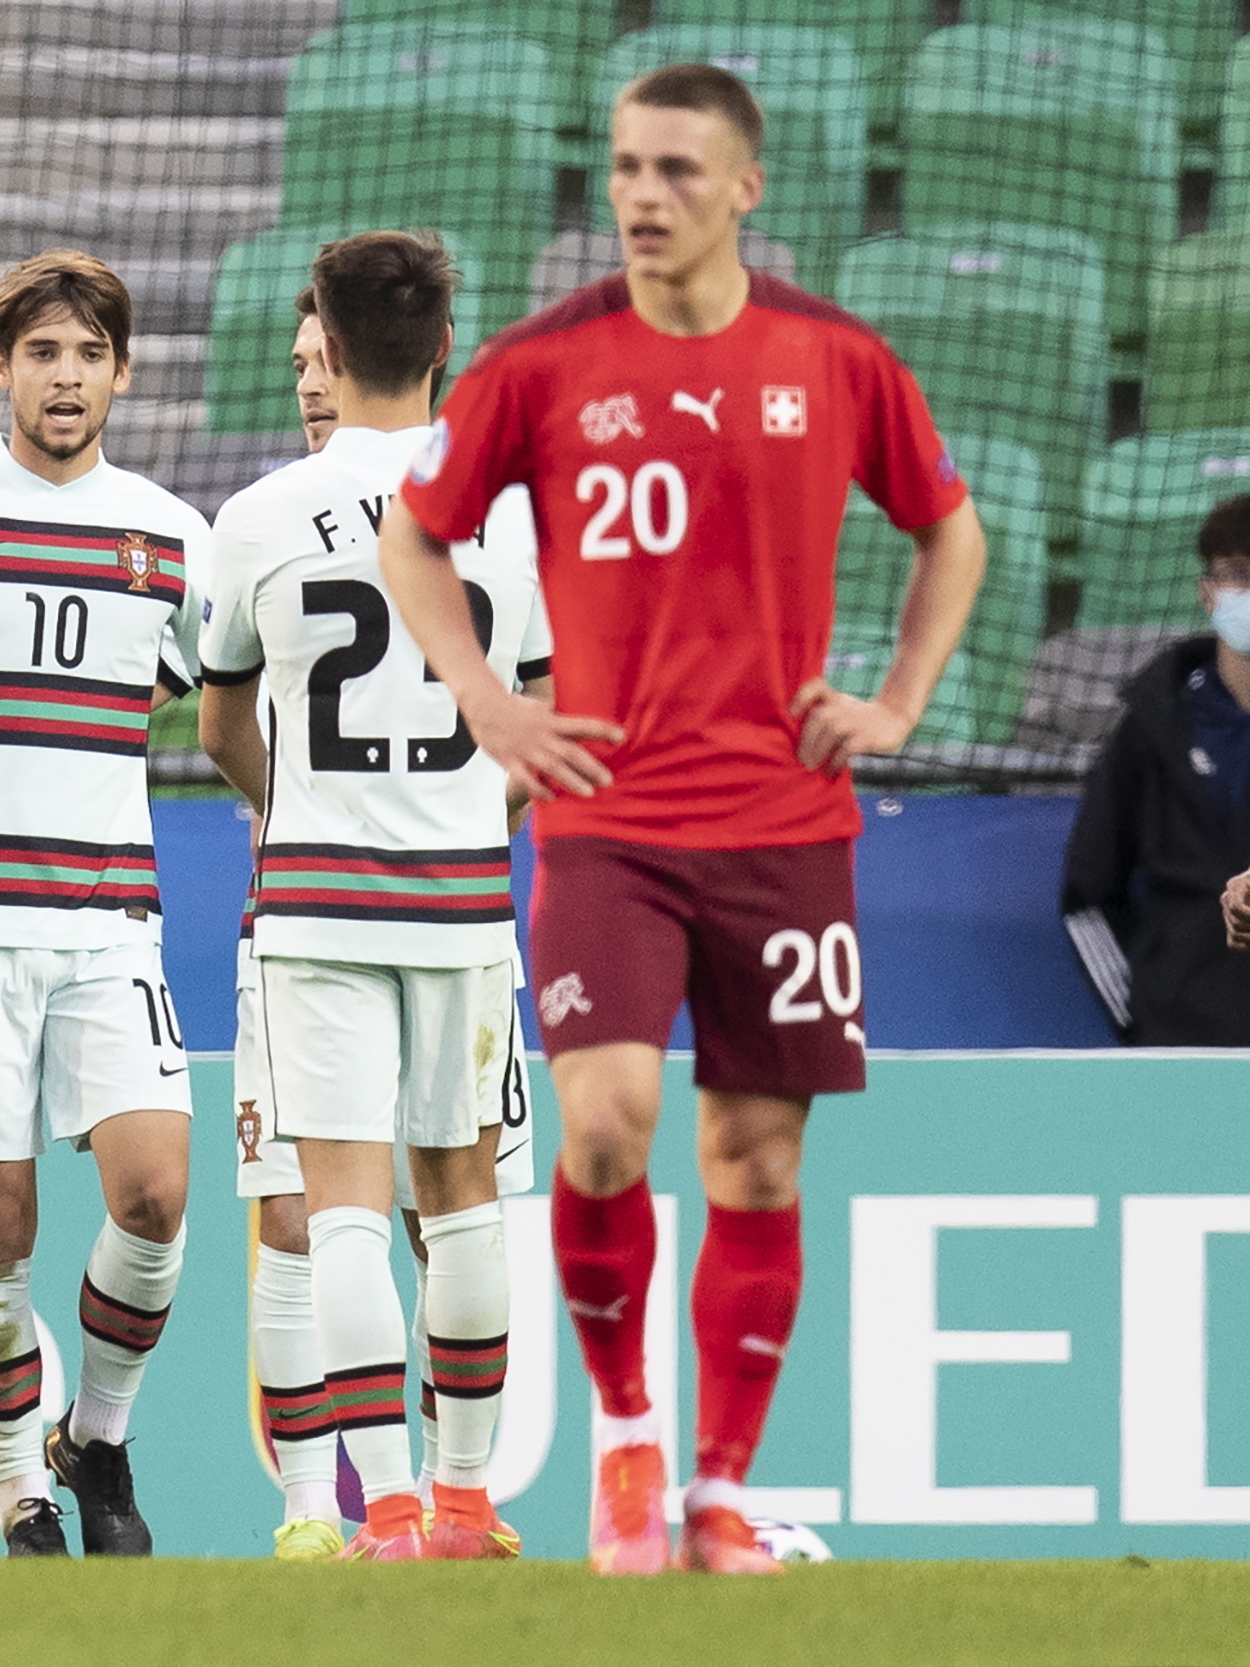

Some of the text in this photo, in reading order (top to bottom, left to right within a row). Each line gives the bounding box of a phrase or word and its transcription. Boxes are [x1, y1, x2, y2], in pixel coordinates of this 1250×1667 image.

[312, 509, 356, 553] F.
[576, 461, 688, 561] 20
[25, 592, 88, 669] 10
[762, 920, 862, 1023] 20
